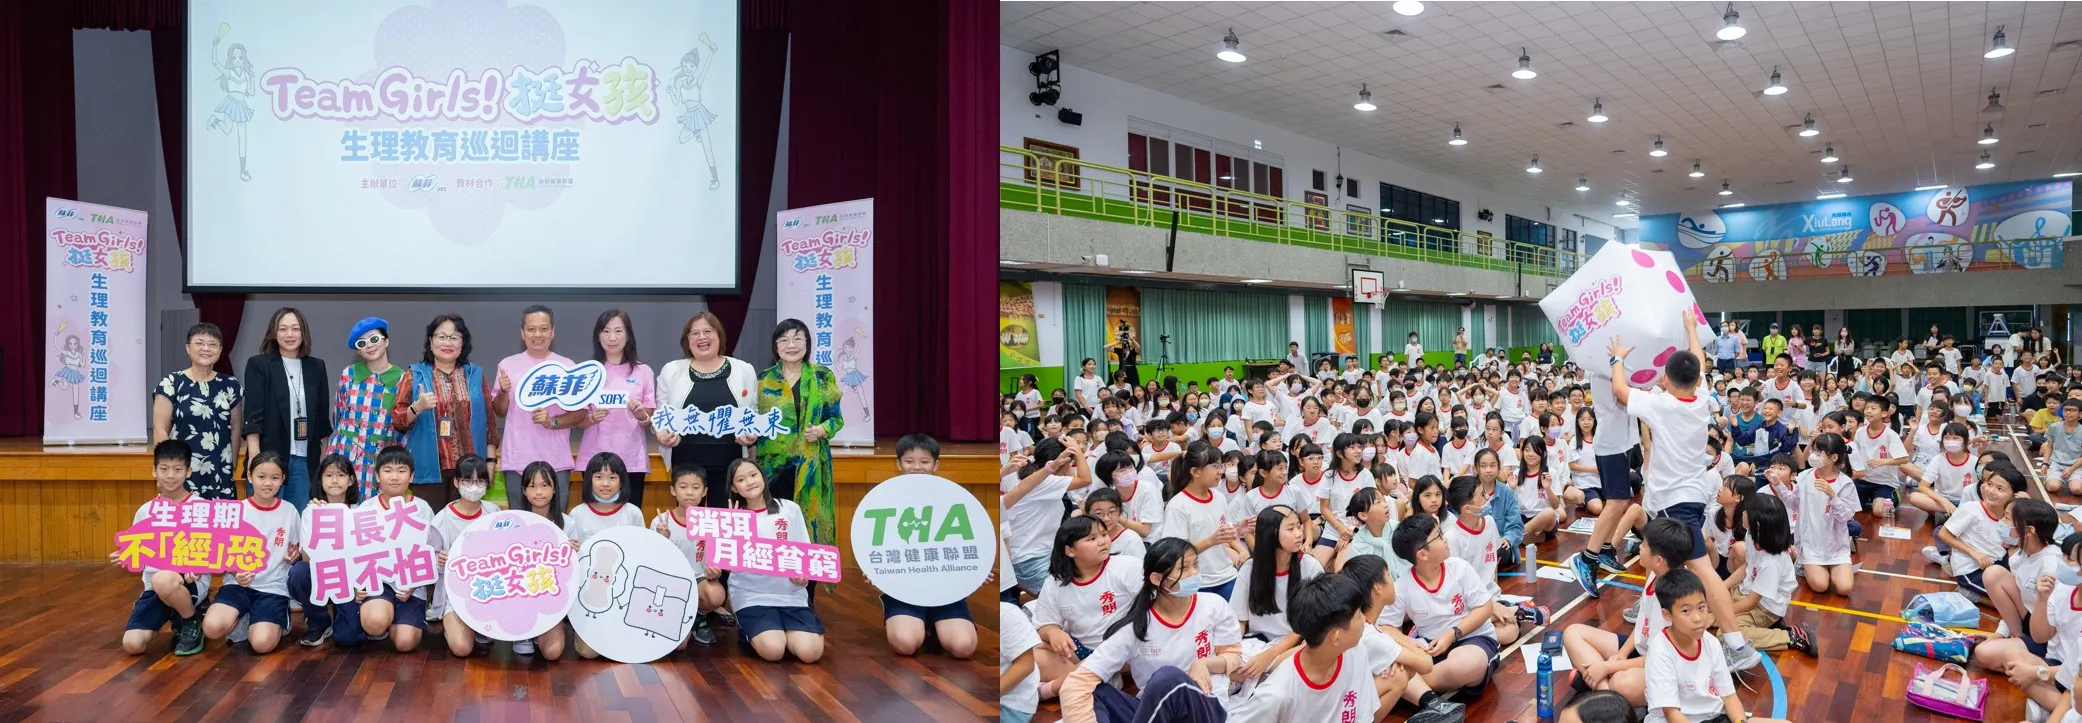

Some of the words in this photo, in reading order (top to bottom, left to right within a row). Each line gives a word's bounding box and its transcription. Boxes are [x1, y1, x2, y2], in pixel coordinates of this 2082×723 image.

[266, 73, 375, 114] Team
[378, 72, 495, 114] Girls!
[508, 62, 653, 119] 挺女孩
[340, 129, 581, 163] 生理教育巡迴講座
[90, 213, 114, 225] THA
[815, 213, 838, 226] THA
[1801, 214, 1852, 233] XiuLang
[52, 230, 96, 245] Team
[97, 230, 144, 253] Girls!
[781, 238, 821, 254] Team
[822, 230, 869, 245] Girls!
[67, 246, 131, 270] 挺女孩
[793, 247, 856, 270] 挺女孩
[1579, 276, 1619, 306] Girls!
[1568, 296, 1619, 344] 挺女孩
[89, 272, 109, 422] 生理教育巡迴講座
[528, 373, 590, 397] 蘇菲
[598, 393, 626, 405] SOFY
[150, 501, 242, 529] 生理期
[308, 500, 427, 551] 月長大
[688, 508, 752, 539] 消弭
[864, 503, 975, 546] THA
[451, 554, 508, 578] Team
[508, 544, 570, 565] Girls!
[713, 537, 839, 579] 月經貧窮
[868, 545, 979, 564] 台灣健康聯盟
[315, 543, 435, 602] 月不怕
[472, 564, 557, 600] 挺女孩
[874, 567, 906, 575] Taiwan
[908, 564, 939, 574] Health
[940, 564, 978, 573] Alliance
[1098, 590, 1117, 616] 秀朗
[1194, 629, 1212, 659] 秀朗
